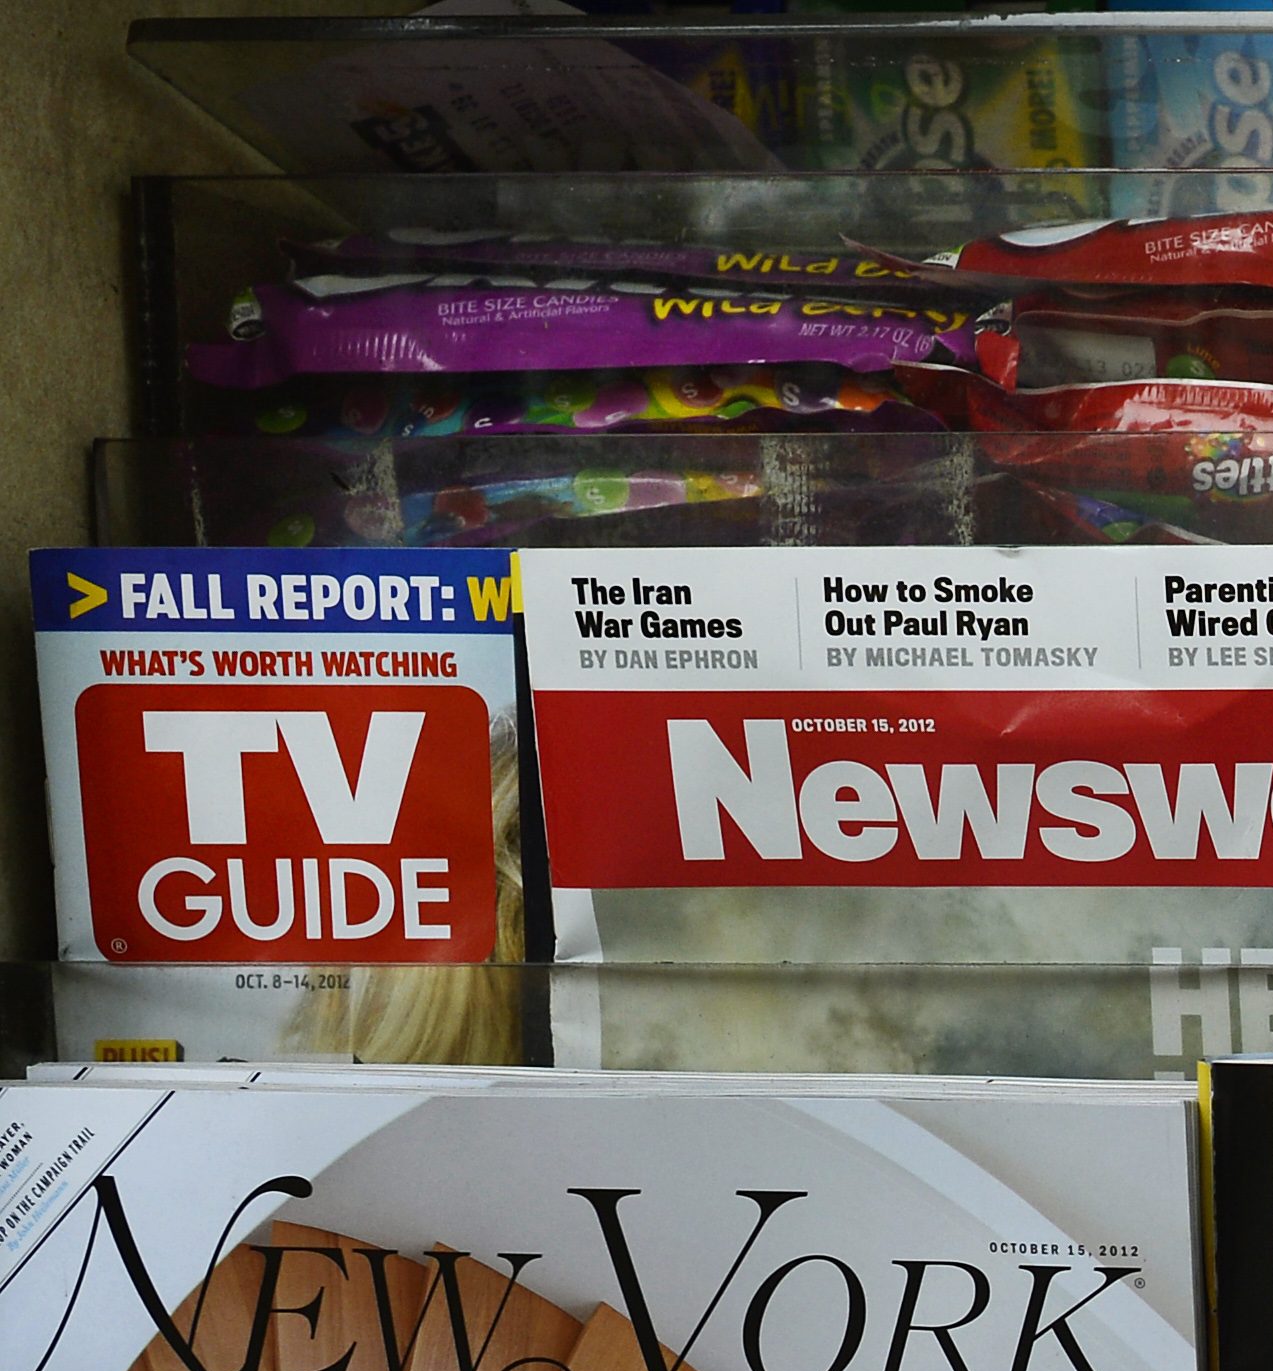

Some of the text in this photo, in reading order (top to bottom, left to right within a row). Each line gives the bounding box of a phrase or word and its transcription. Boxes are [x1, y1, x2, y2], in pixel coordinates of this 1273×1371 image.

[120, 573, 234, 620] FALL
[248, 576, 455, 621] REPORT:
[572, 577, 692, 605] The Iran
[824, 577, 1034, 603] How to Smoke
[575, 611, 743, 638] War Games
[825, 611, 1029, 641] Out Paul Ryan
[1167, 608, 1258, 637] Wired
[100, 650, 457, 677] WHAT'S WORTH WATCHING
[579, 650, 758, 670] BY DAN EPHRON
[827, 647, 1099, 668] BY MICHAEL TOMASKY
[1168, 646, 1198, 667] BY
[1206, 646, 1247, 667] LEE
[142, 711, 426, 845] TV
[137, 857, 451, 941] GUIDE
[5, 1127, 96, 1229] ON THE CAMPAIGN TRAIL
[990, 1241, 1139, 1258] OCTOBER 15, 2012
